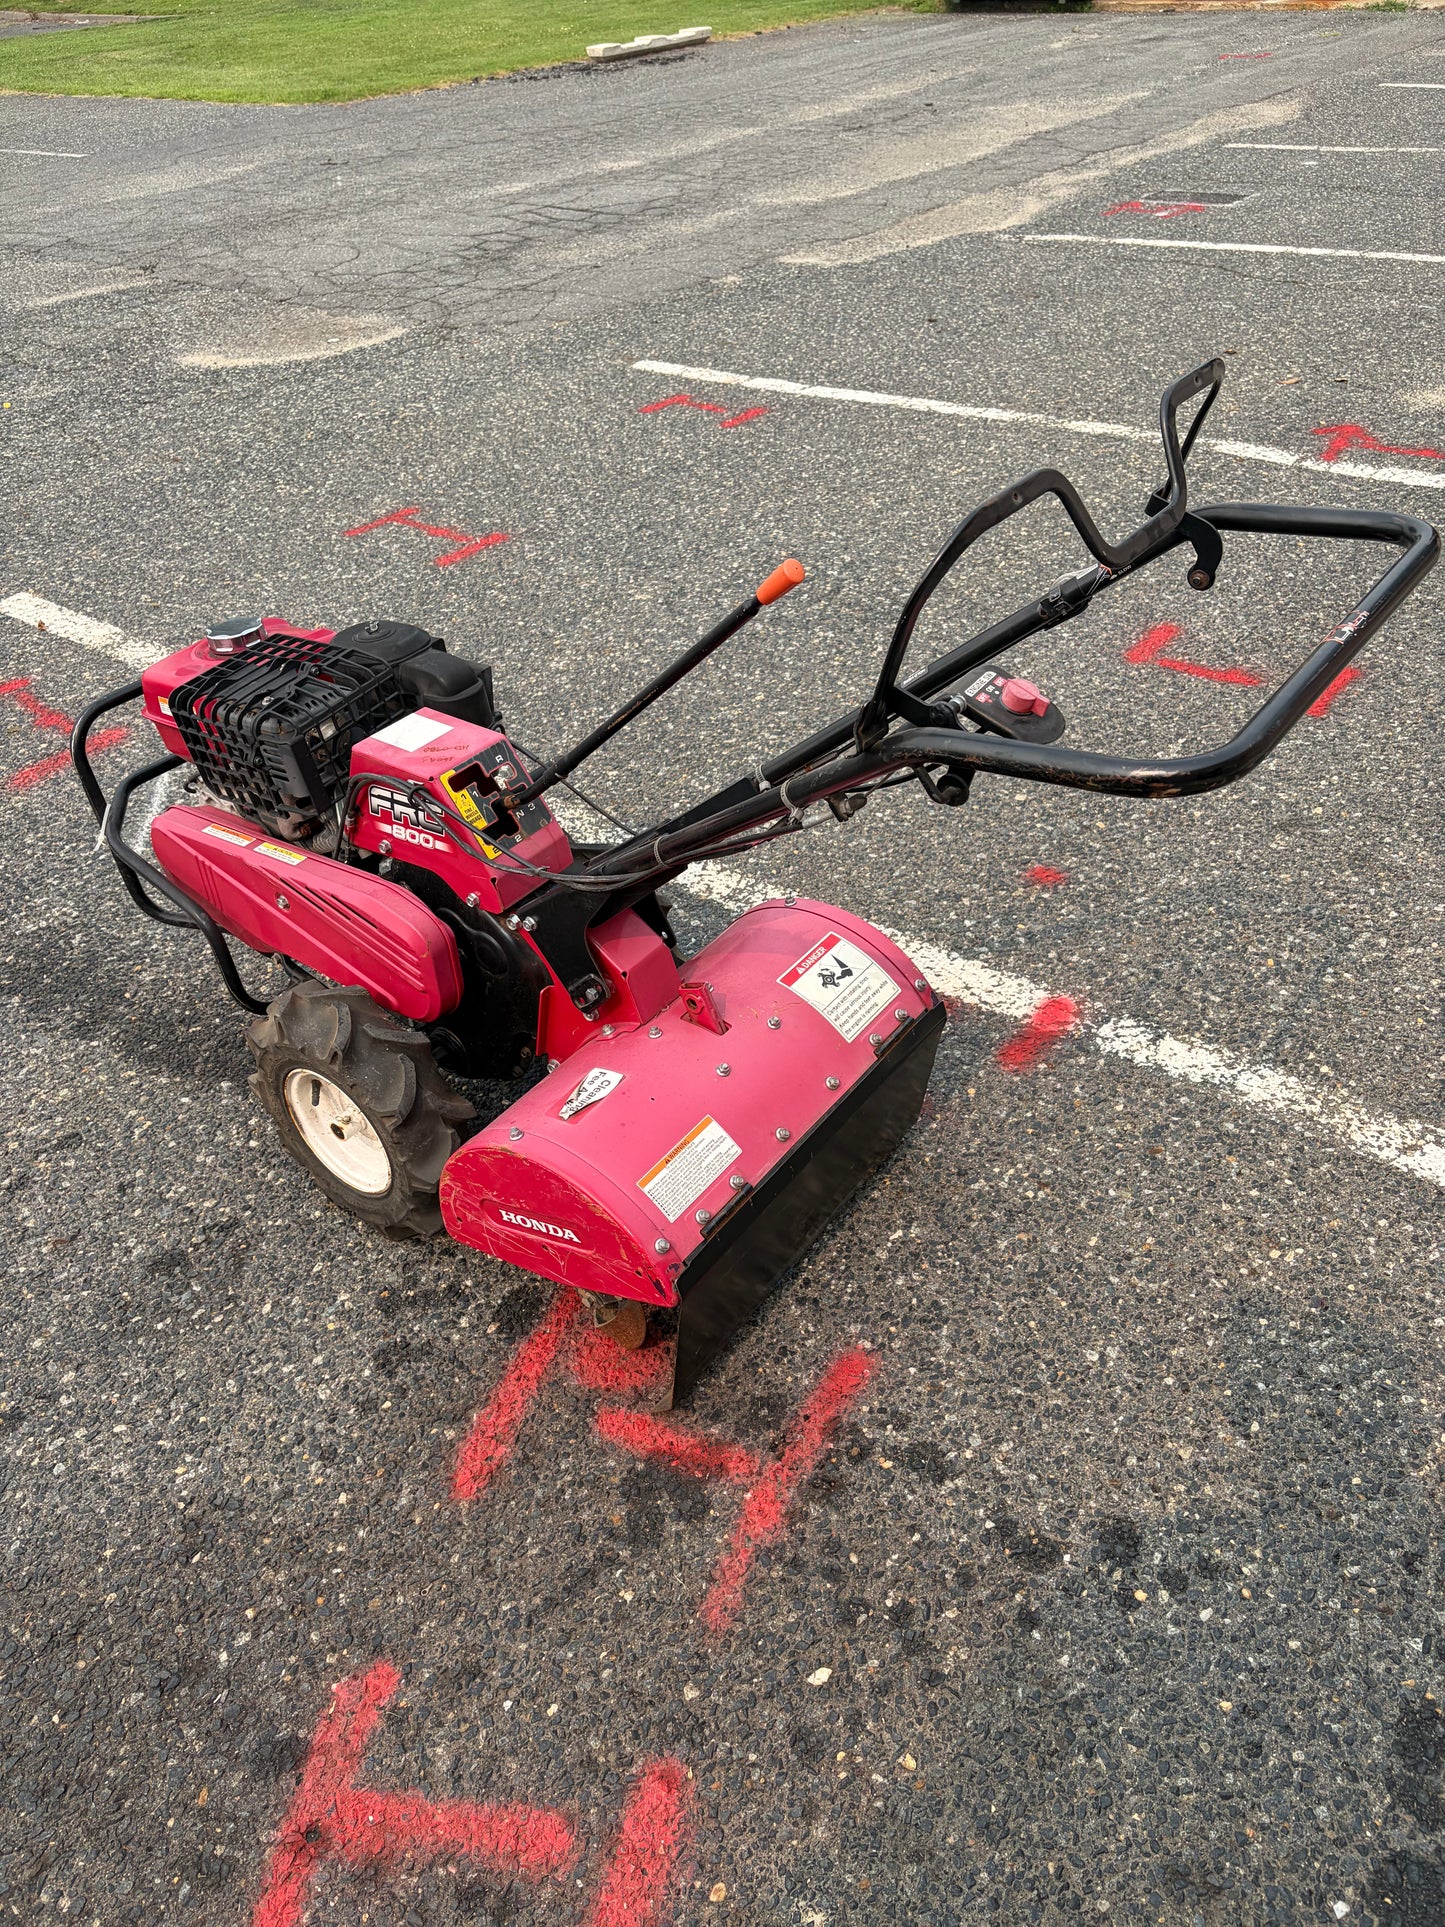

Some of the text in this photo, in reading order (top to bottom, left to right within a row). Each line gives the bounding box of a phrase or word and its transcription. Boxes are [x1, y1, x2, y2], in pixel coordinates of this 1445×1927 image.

[495, 755, 503, 763] R
[368, 784, 444, 837] FRC
[516, 810, 525, 818] N
[392, 824, 434, 849] 800
[802, 946, 826, 968] DANGER
[588, 1072, 607, 1085] Fee
[570, 1080, 611, 1111] Cleaning
[669, 1139, 690, 1159] WARNING
[499, 1209, 581, 1243] HONDA
